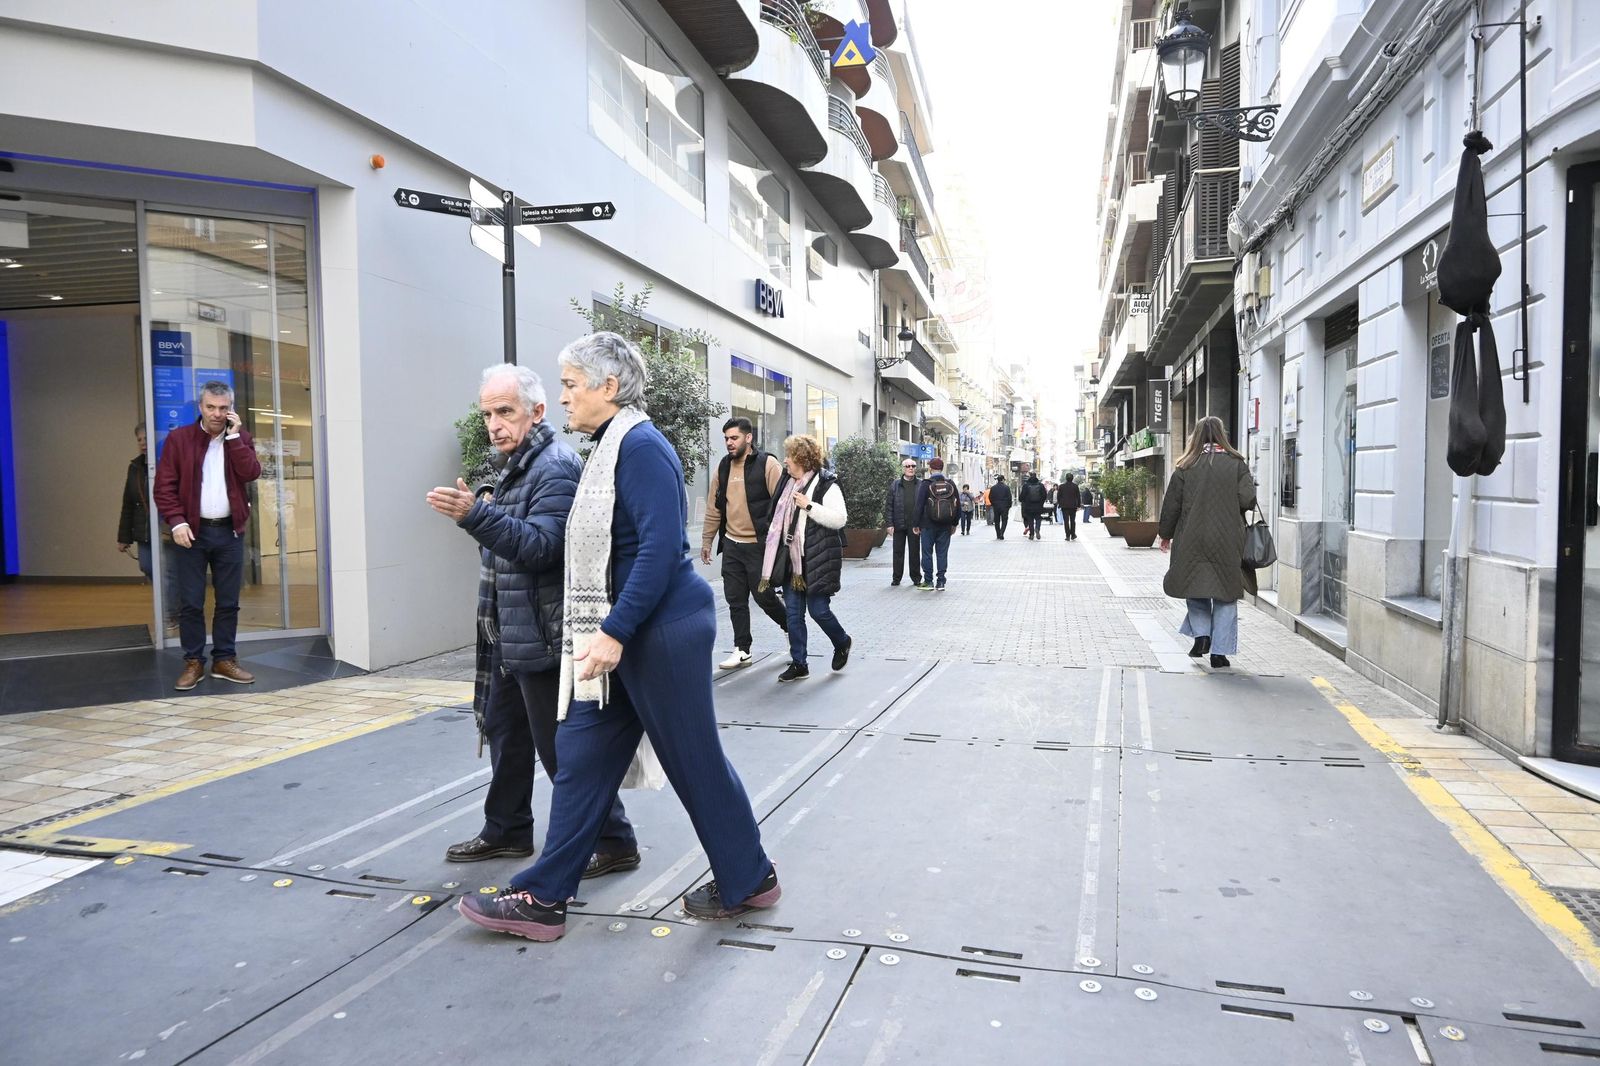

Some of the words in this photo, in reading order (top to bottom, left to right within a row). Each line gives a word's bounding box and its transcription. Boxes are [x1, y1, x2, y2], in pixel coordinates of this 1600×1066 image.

[440, 198, 454, 206] Casa
[522, 209, 540, 217] Iglesia
[554, 207, 584, 215] Concepción
[755, 278, 784, 318] BBVA
[1431, 330, 1450, 346] OFERTA
[158, 341, 185, 349] BBVA
[1154, 389, 1162, 423] TIGER
